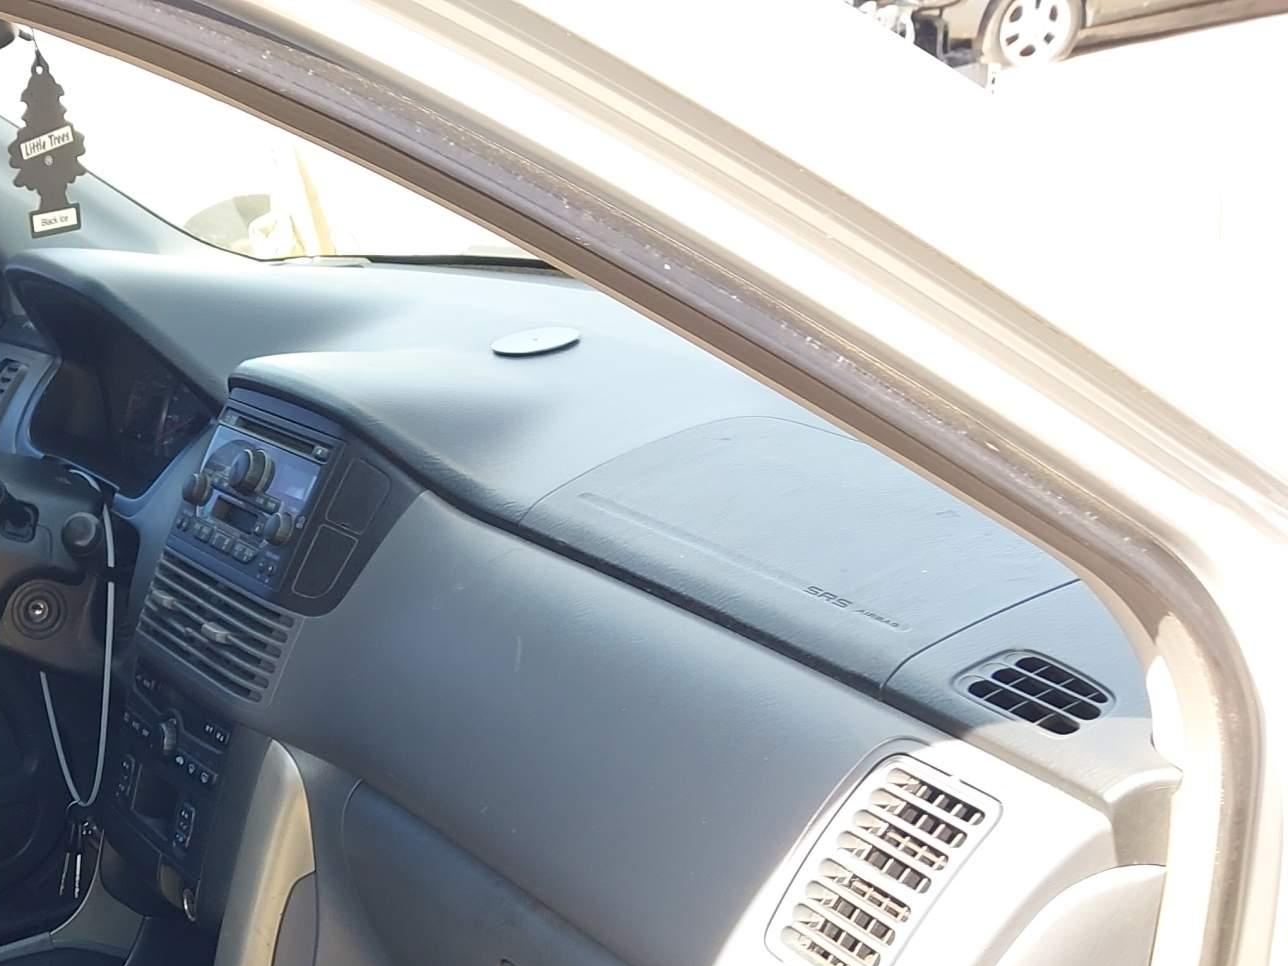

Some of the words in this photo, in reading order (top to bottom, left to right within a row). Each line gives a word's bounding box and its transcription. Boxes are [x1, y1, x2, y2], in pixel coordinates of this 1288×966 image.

[24, 137, 46, 156] Little
[48, 132, 70, 146] Trees
[802, 585, 853, 608] SRS
